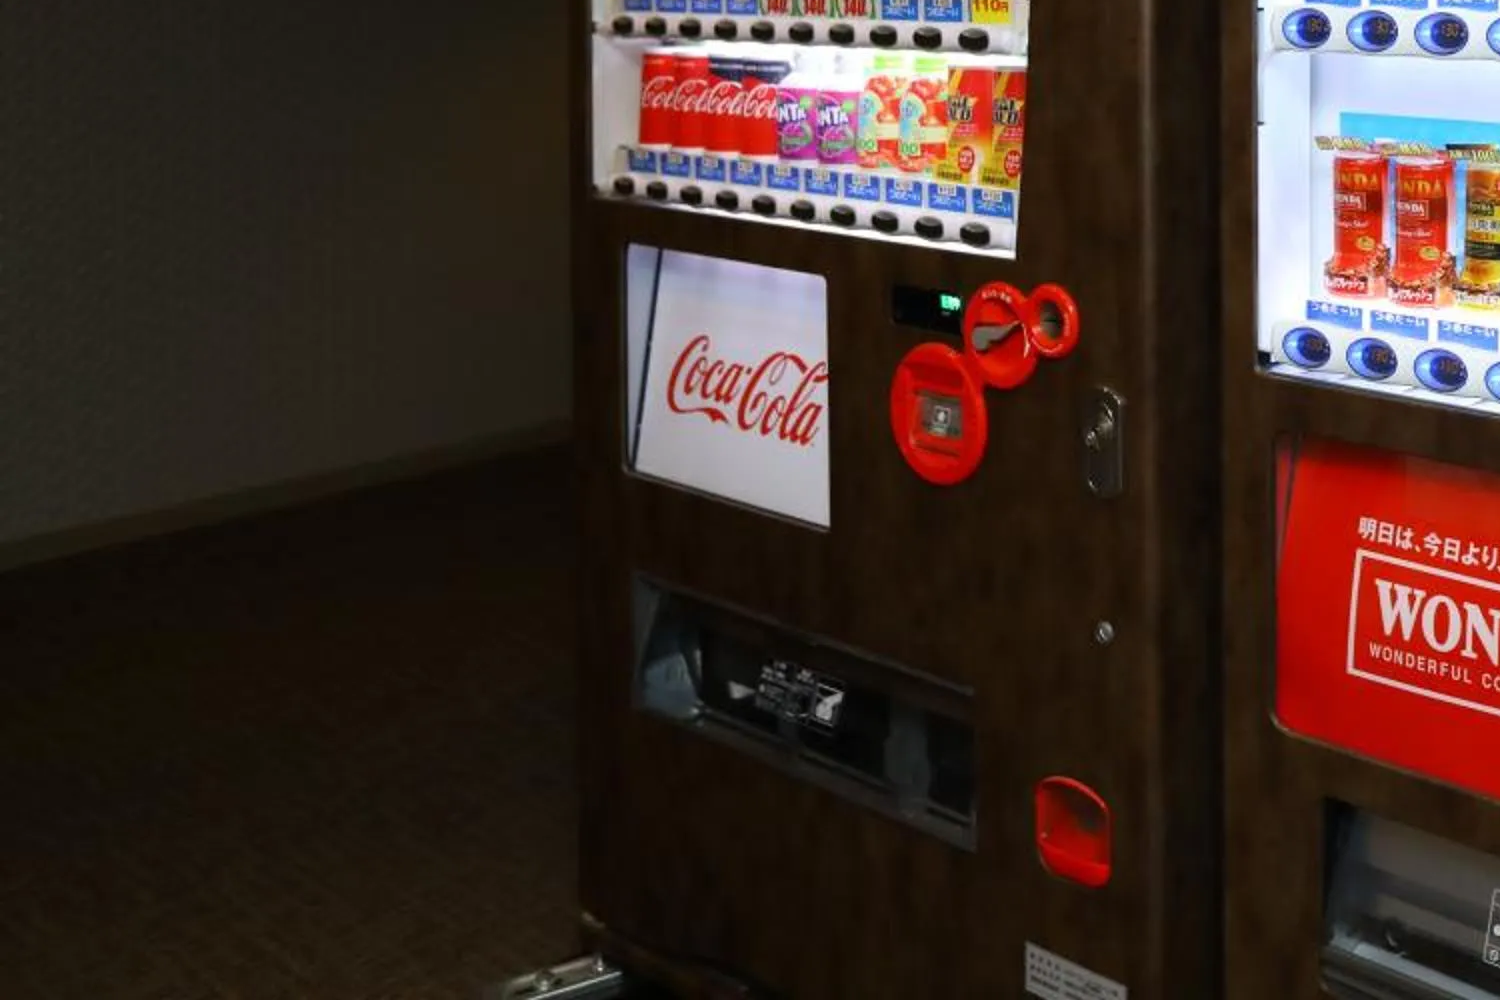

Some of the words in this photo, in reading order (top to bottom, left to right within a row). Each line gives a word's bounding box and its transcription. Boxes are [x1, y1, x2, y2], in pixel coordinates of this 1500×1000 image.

[779, 104, 806, 122] NTA
[667, 335, 830, 446] Coca-Cola
[1369, 643, 1472, 684] WONDERFUL
